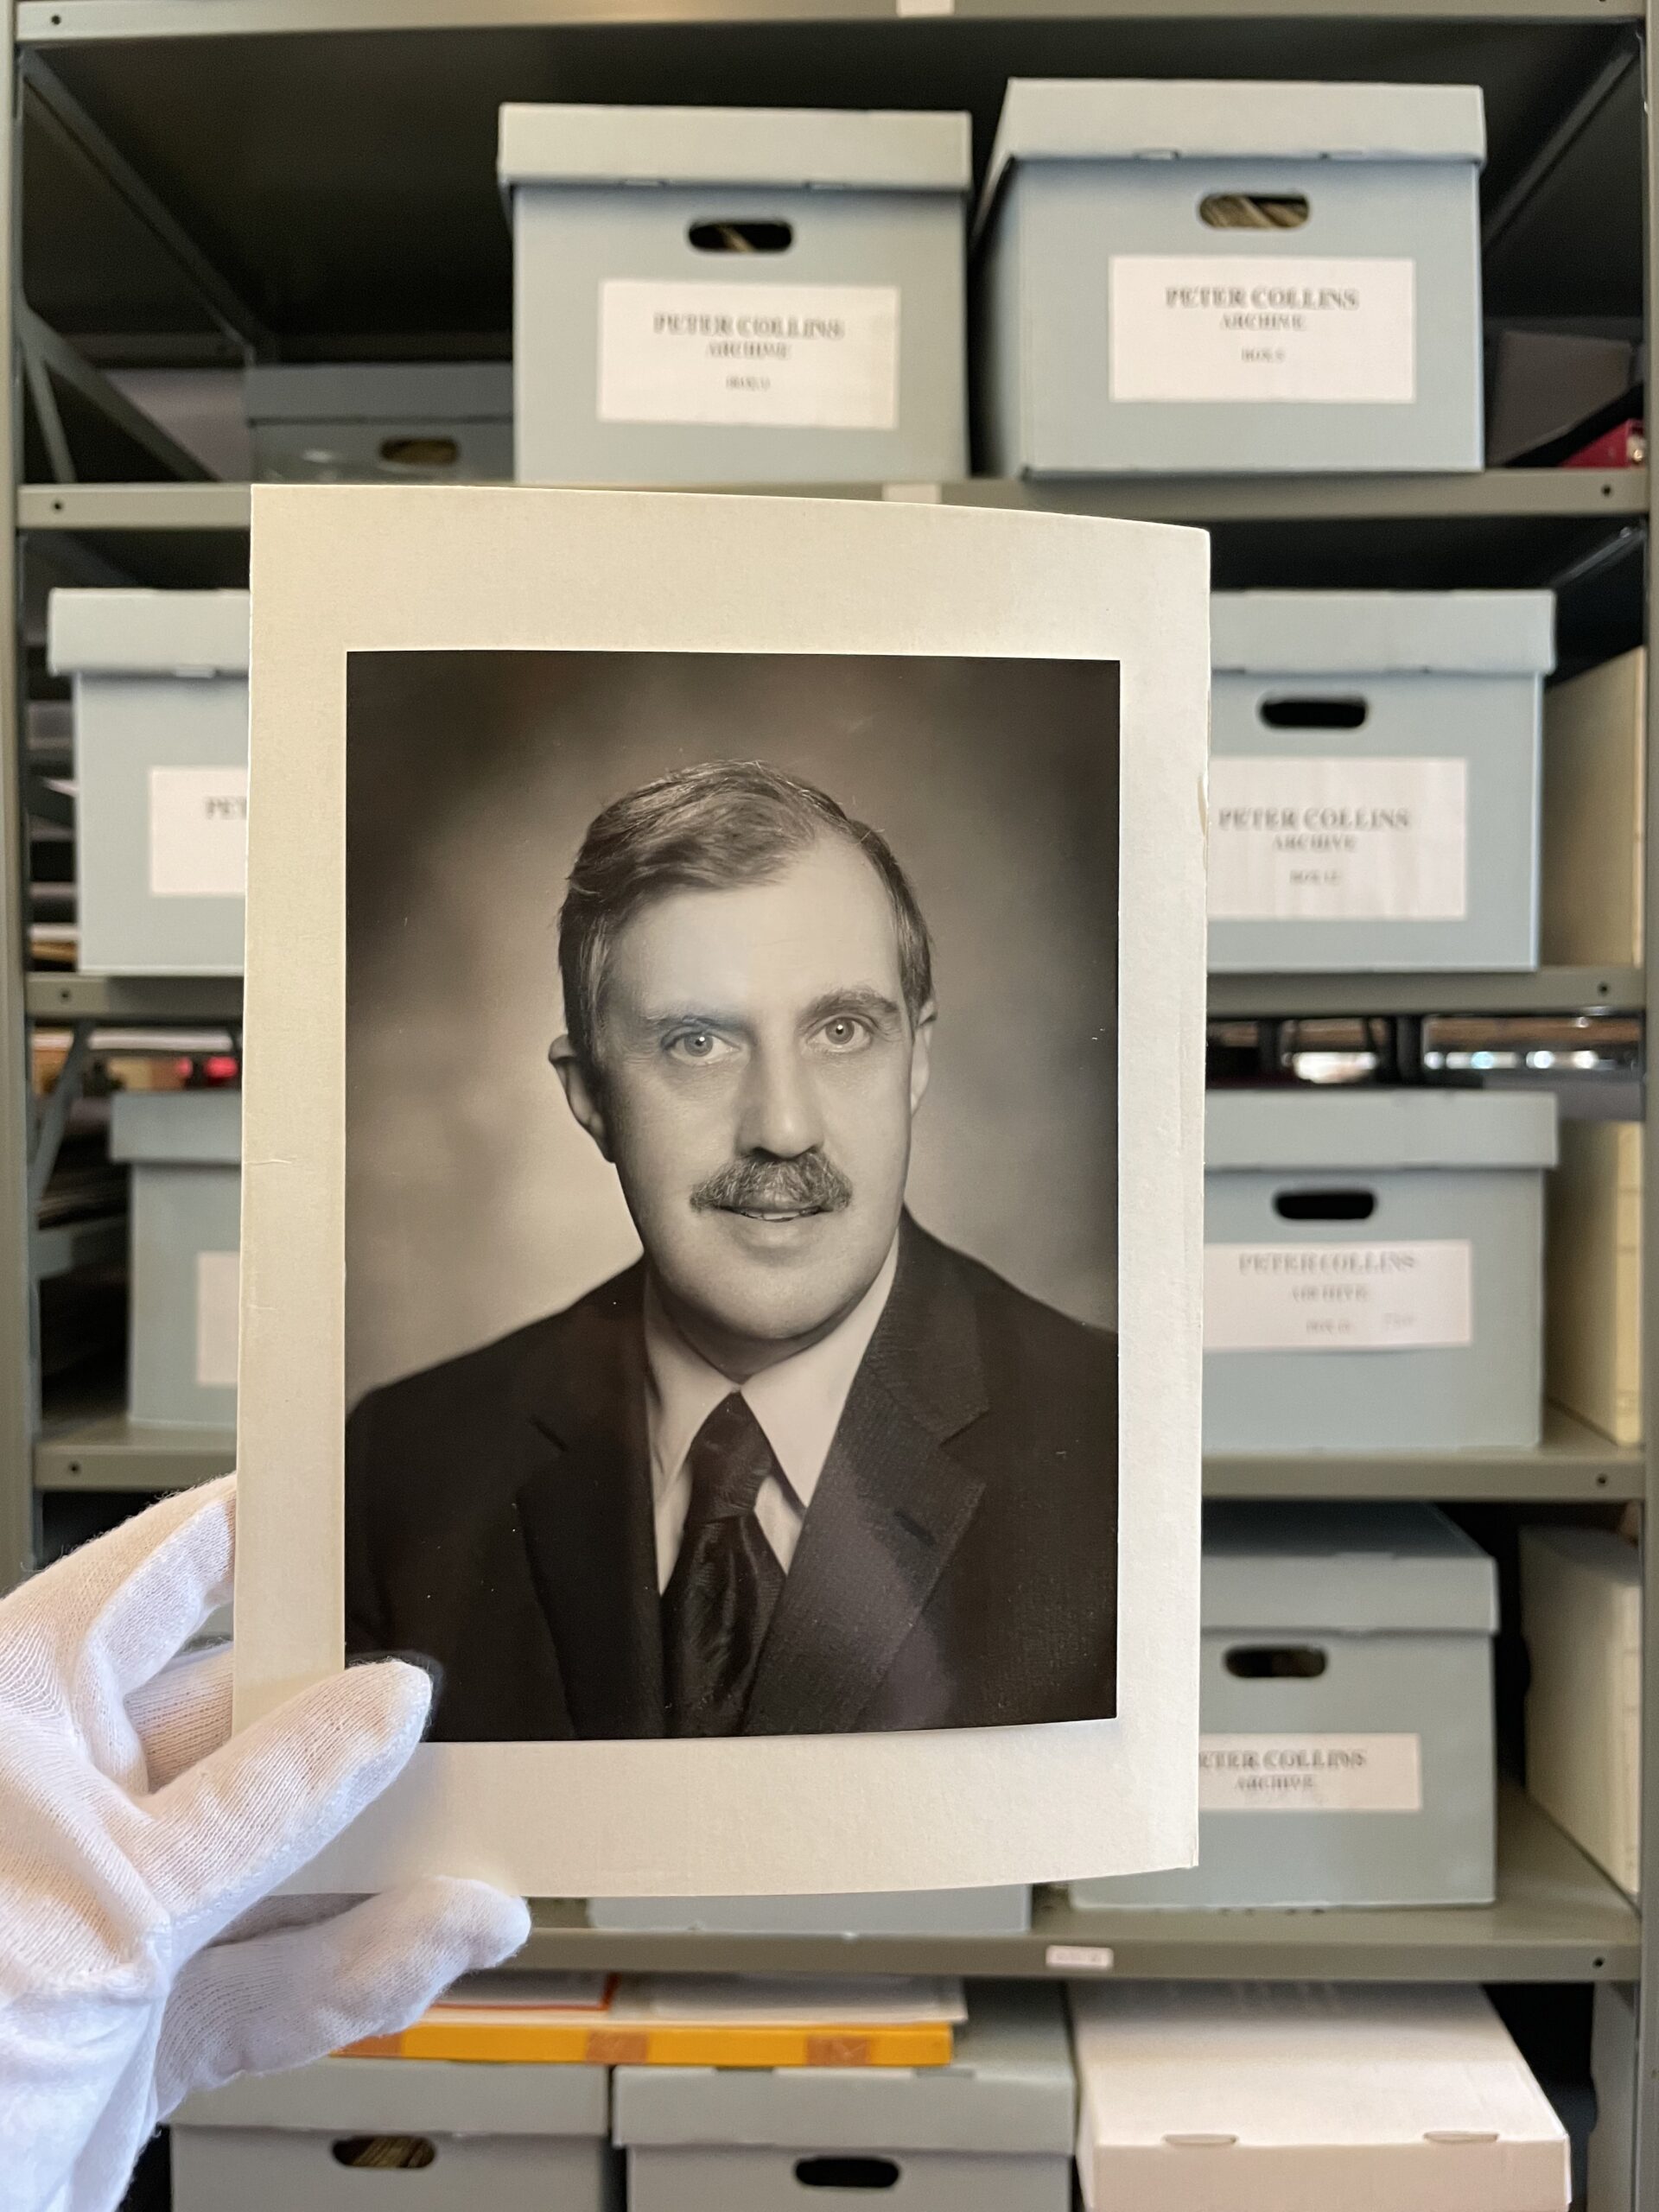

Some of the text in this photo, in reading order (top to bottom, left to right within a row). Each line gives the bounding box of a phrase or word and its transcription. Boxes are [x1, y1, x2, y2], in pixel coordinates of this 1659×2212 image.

[1165, 287, 1360, 310] PETER COLLINS
[653, 313, 845, 340] PETER COLLINS
[1221, 313, 1306, 331] ARCHIVE
[706, 341, 791, 360] ARCHIVE
[1218, 807, 1410, 831] PETER COLLINS
[1273, 833, 1357, 853] ARCHIVE
[1238, 1251, 1415, 1275] PETER COLLINS
[1198, 1748, 1367, 1769] ETER COLLINS
[1236, 1773, 1317, 1791] ARCHIVE
